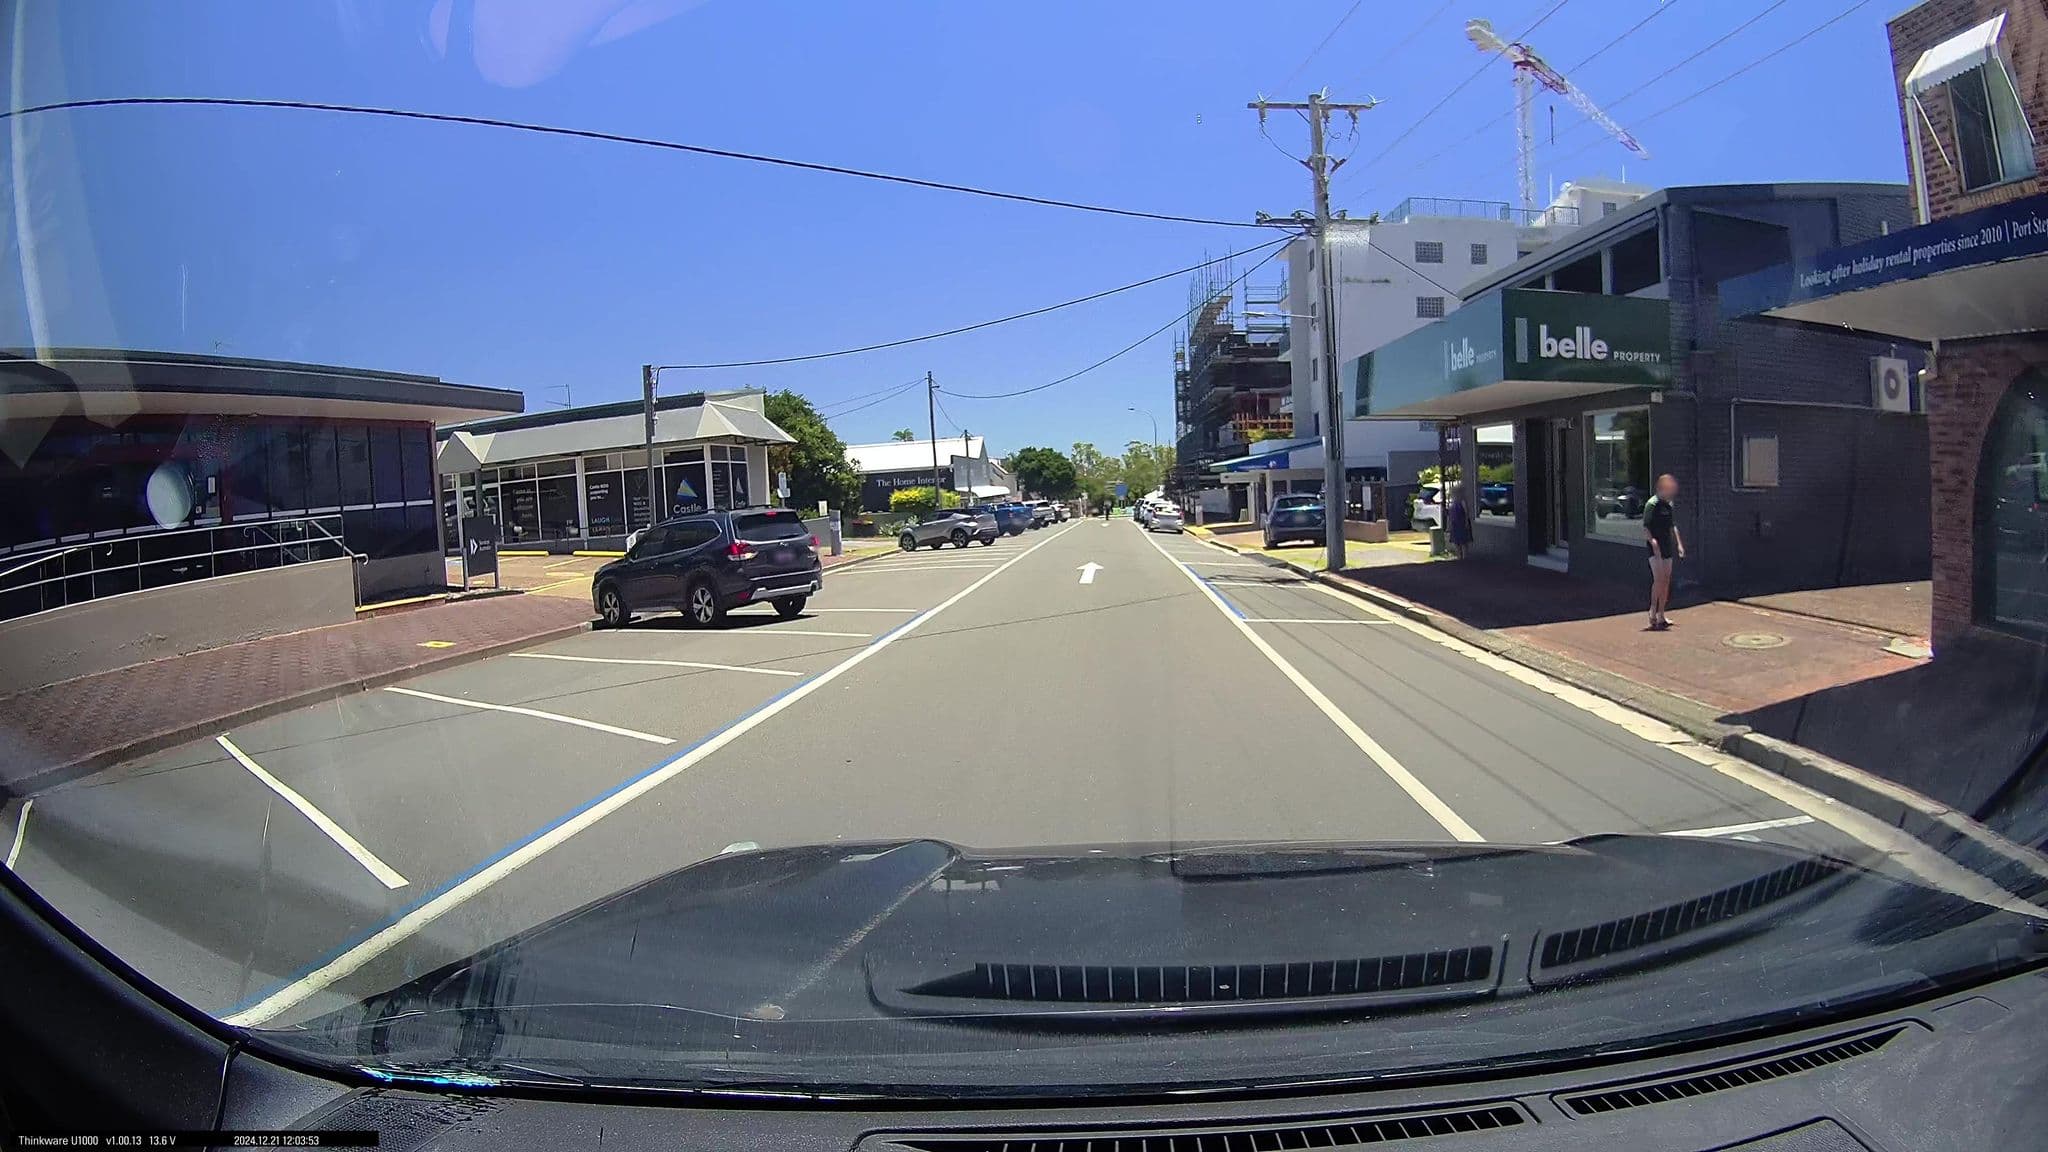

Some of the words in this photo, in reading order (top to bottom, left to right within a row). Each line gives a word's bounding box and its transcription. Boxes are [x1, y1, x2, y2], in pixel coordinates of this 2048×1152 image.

[1800, 268, 1831, 288] Looking
[1832, 264, 1851, 284] after
[1852, 255, 1884, 274] holiday
[1886, 246, 1911, 268] rental
[1913, 238, 1956, 266] properties
[1957, 234, 1979, 251] since
[1981, 225, 2003, 246] 2010
[2012, 220, 2032, 239] Port
[1450, 336, 1475, 371] belle
[1540, 324, 1608, 360] belle
[1613, 351, 1660, 363] PROPERTY
[876, 479, 892, 487] The
[893, 478, 916, 486] Home
[673, 503, 702, 514] Castle
